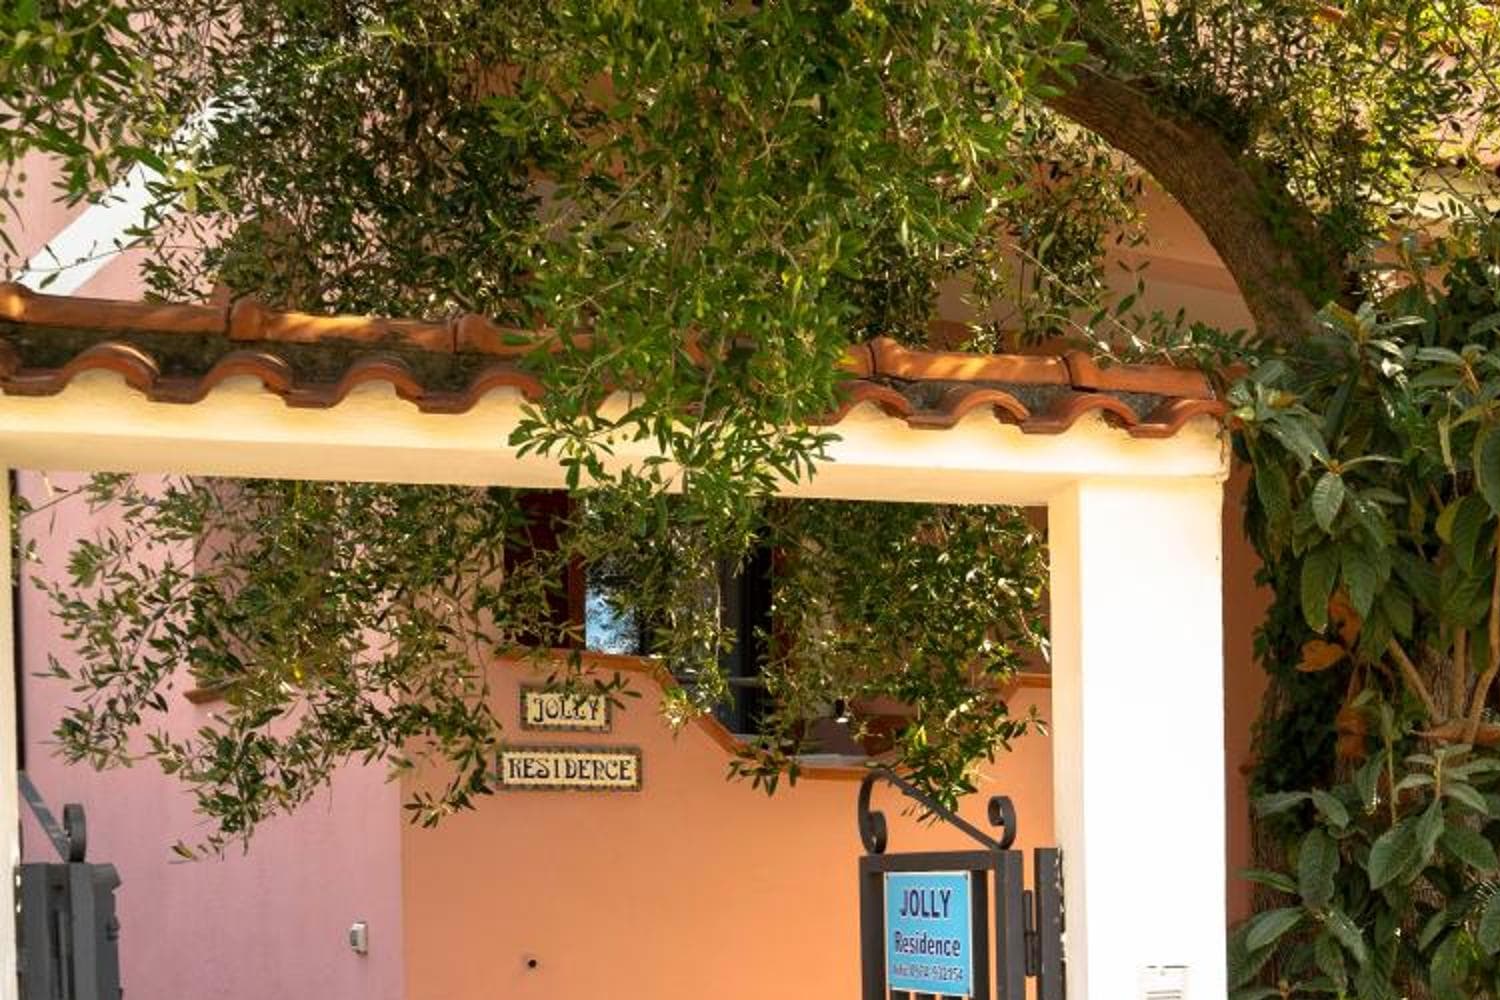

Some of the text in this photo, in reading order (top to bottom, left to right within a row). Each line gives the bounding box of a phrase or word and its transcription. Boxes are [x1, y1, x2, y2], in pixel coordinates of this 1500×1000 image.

[533, 696, 599, 723] JOLLY
[508, 757, 632, 781] RESIDENCE
[900, 889, 951, 918] JOLLY
[895, 931, 961, 957] Residence
